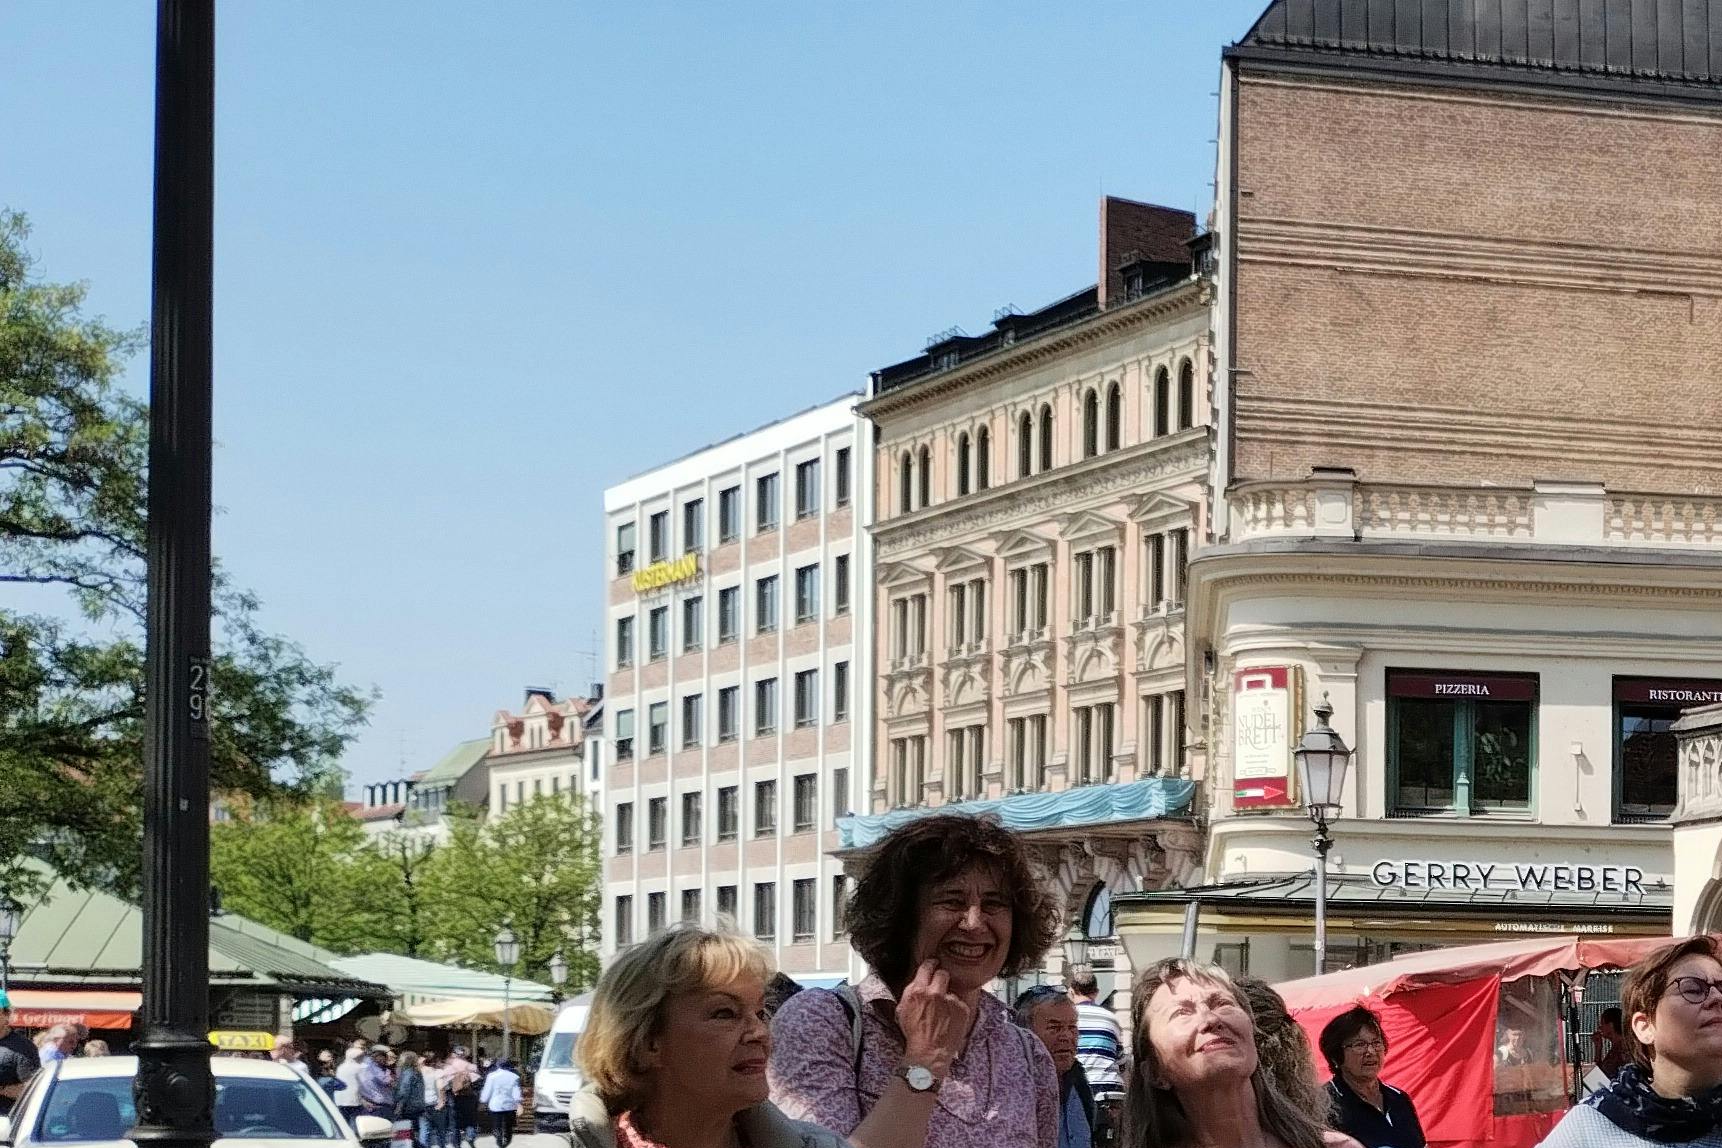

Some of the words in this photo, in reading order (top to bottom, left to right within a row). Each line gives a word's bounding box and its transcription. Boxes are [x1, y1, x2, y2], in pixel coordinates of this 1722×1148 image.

[1435, 683, 1490, 696] PIZZERIA
[1372, 860, 1496, 890] GERRY
[1514, 863, 1648, 894] WEBER
[218, 1034, 267, 1048] TAXI
